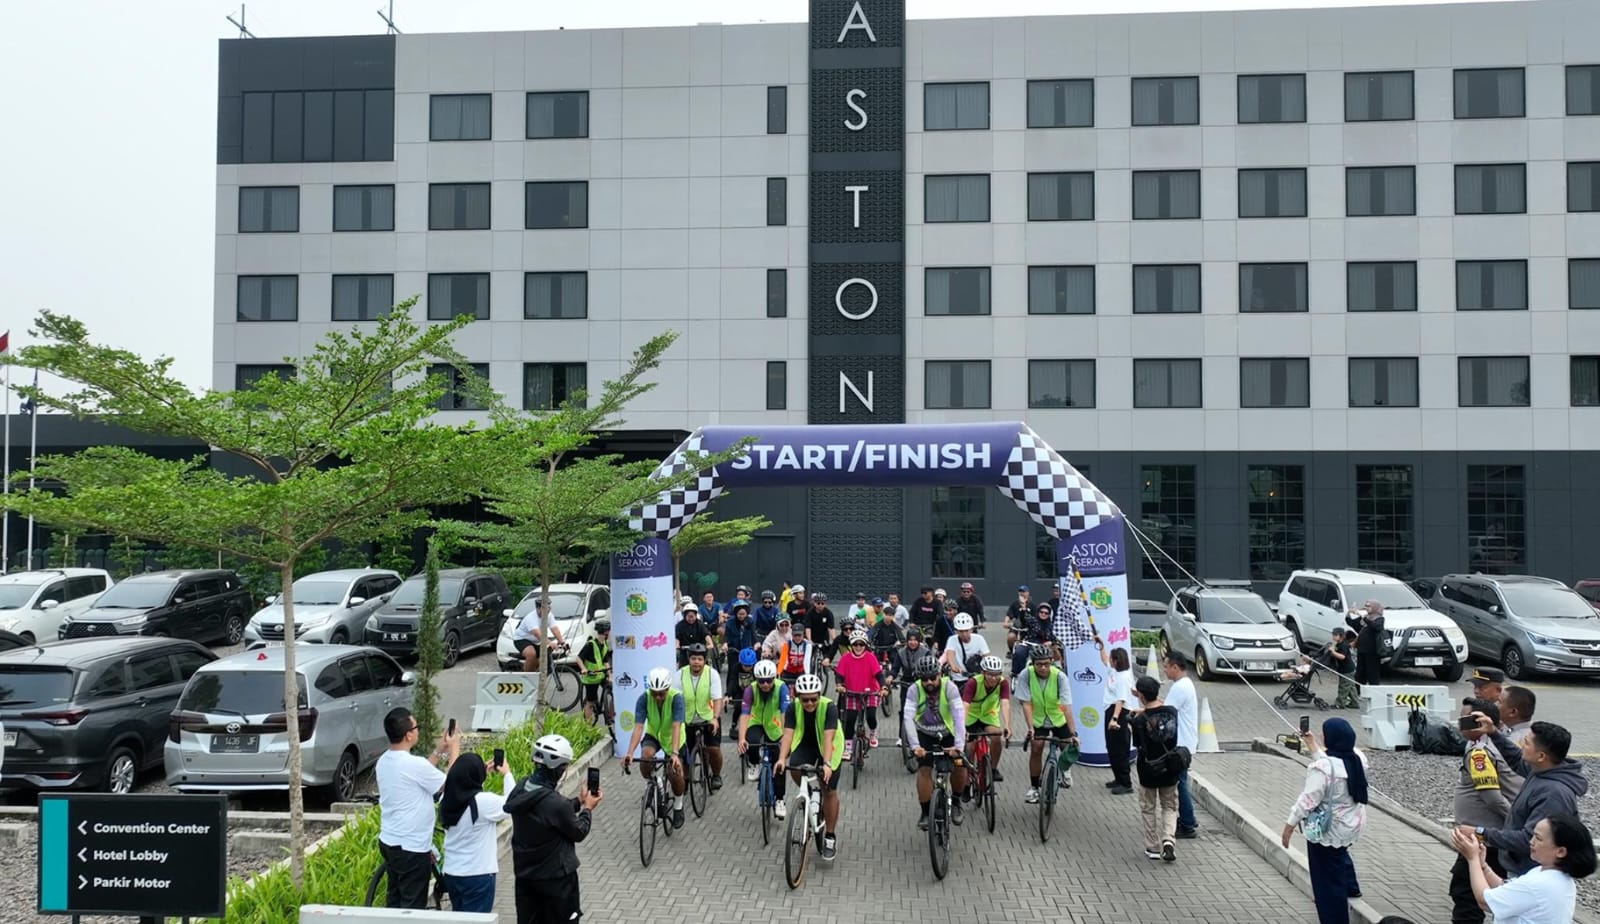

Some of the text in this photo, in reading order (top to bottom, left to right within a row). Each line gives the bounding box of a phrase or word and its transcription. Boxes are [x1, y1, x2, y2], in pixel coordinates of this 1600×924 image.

[836, 0, 878, 413] ASTON
[731, 440, 991, 473] START/FINISH
[1072, 542, 1117, 556] ASTON
[618, 557, 654, 567] SERANG
[1075, 556, 1114, 566] SERANG
[93, 822, 210, 834] Convention Center
[93, 850, 169, 864] Hotel Lobby
[93, 877, 172, 889] Parkir Motor
